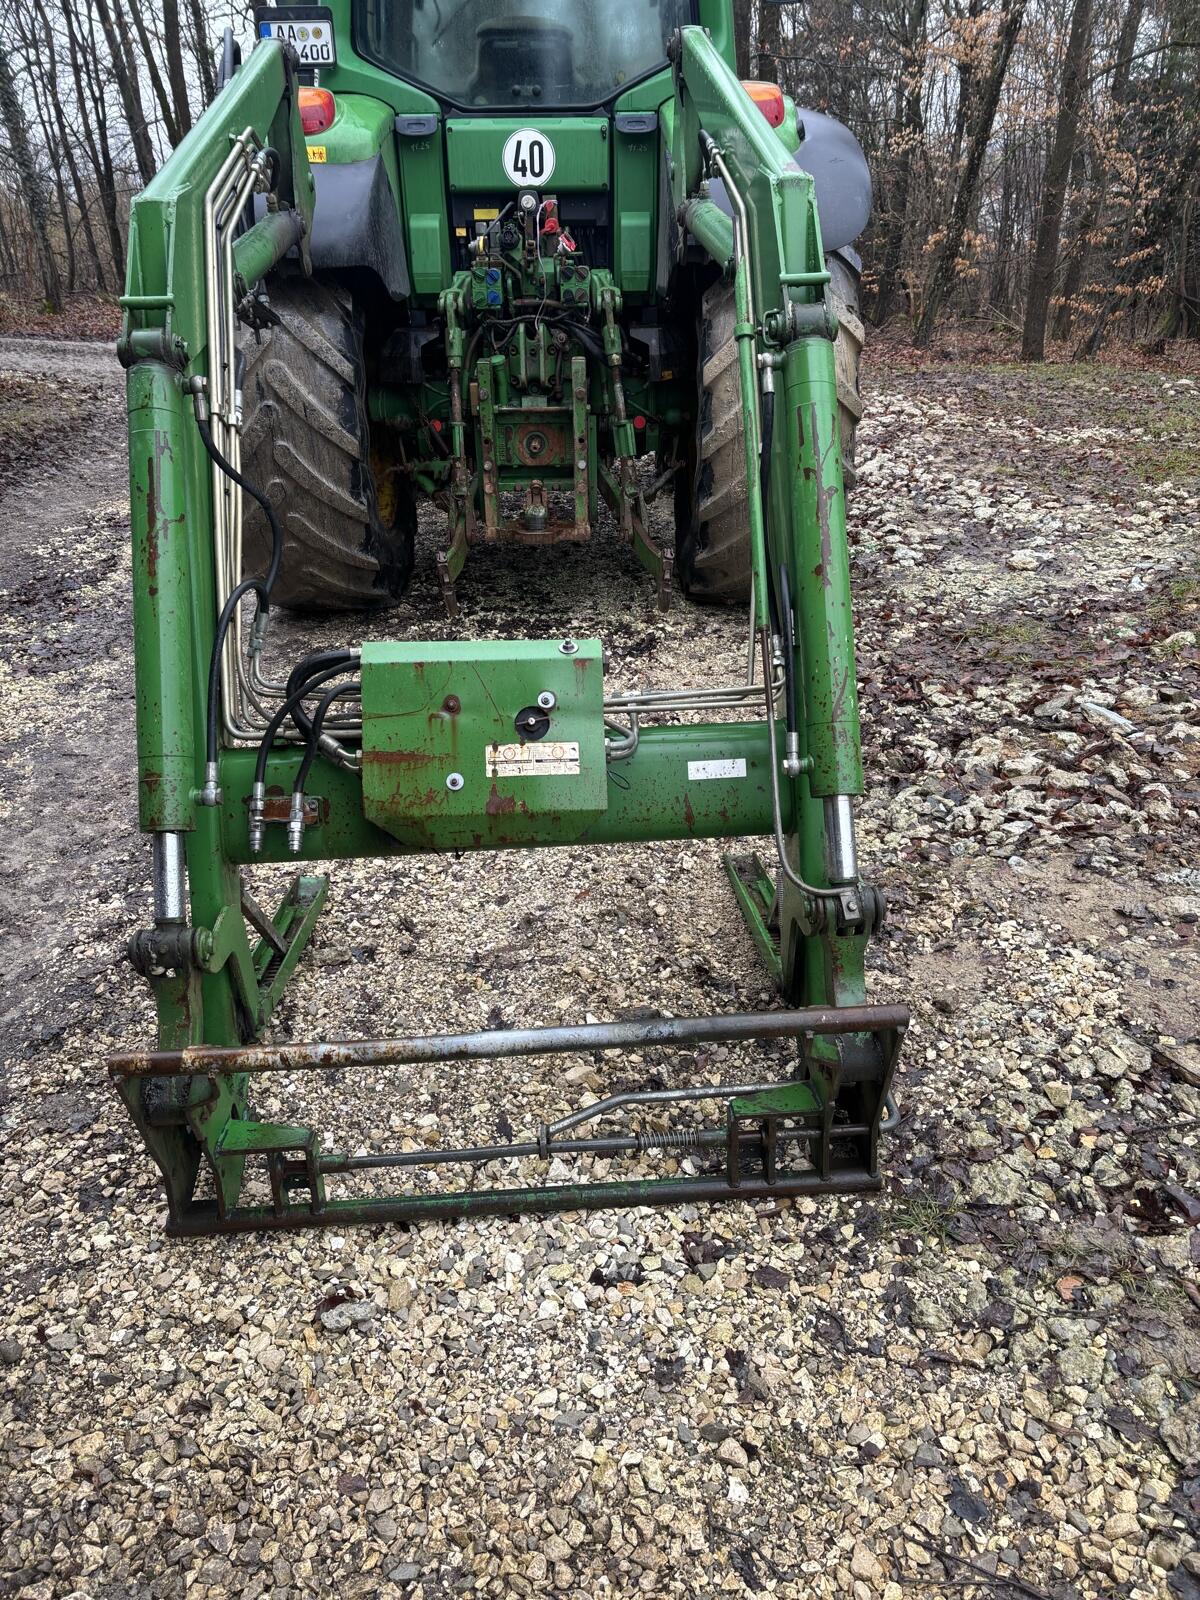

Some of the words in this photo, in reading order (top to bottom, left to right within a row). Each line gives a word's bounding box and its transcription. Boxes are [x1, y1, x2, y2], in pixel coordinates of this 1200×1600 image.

[277, 24, 297, 42] AA
[300, 44, 330, 61] 400
[513, 140, 544, 178] 40
